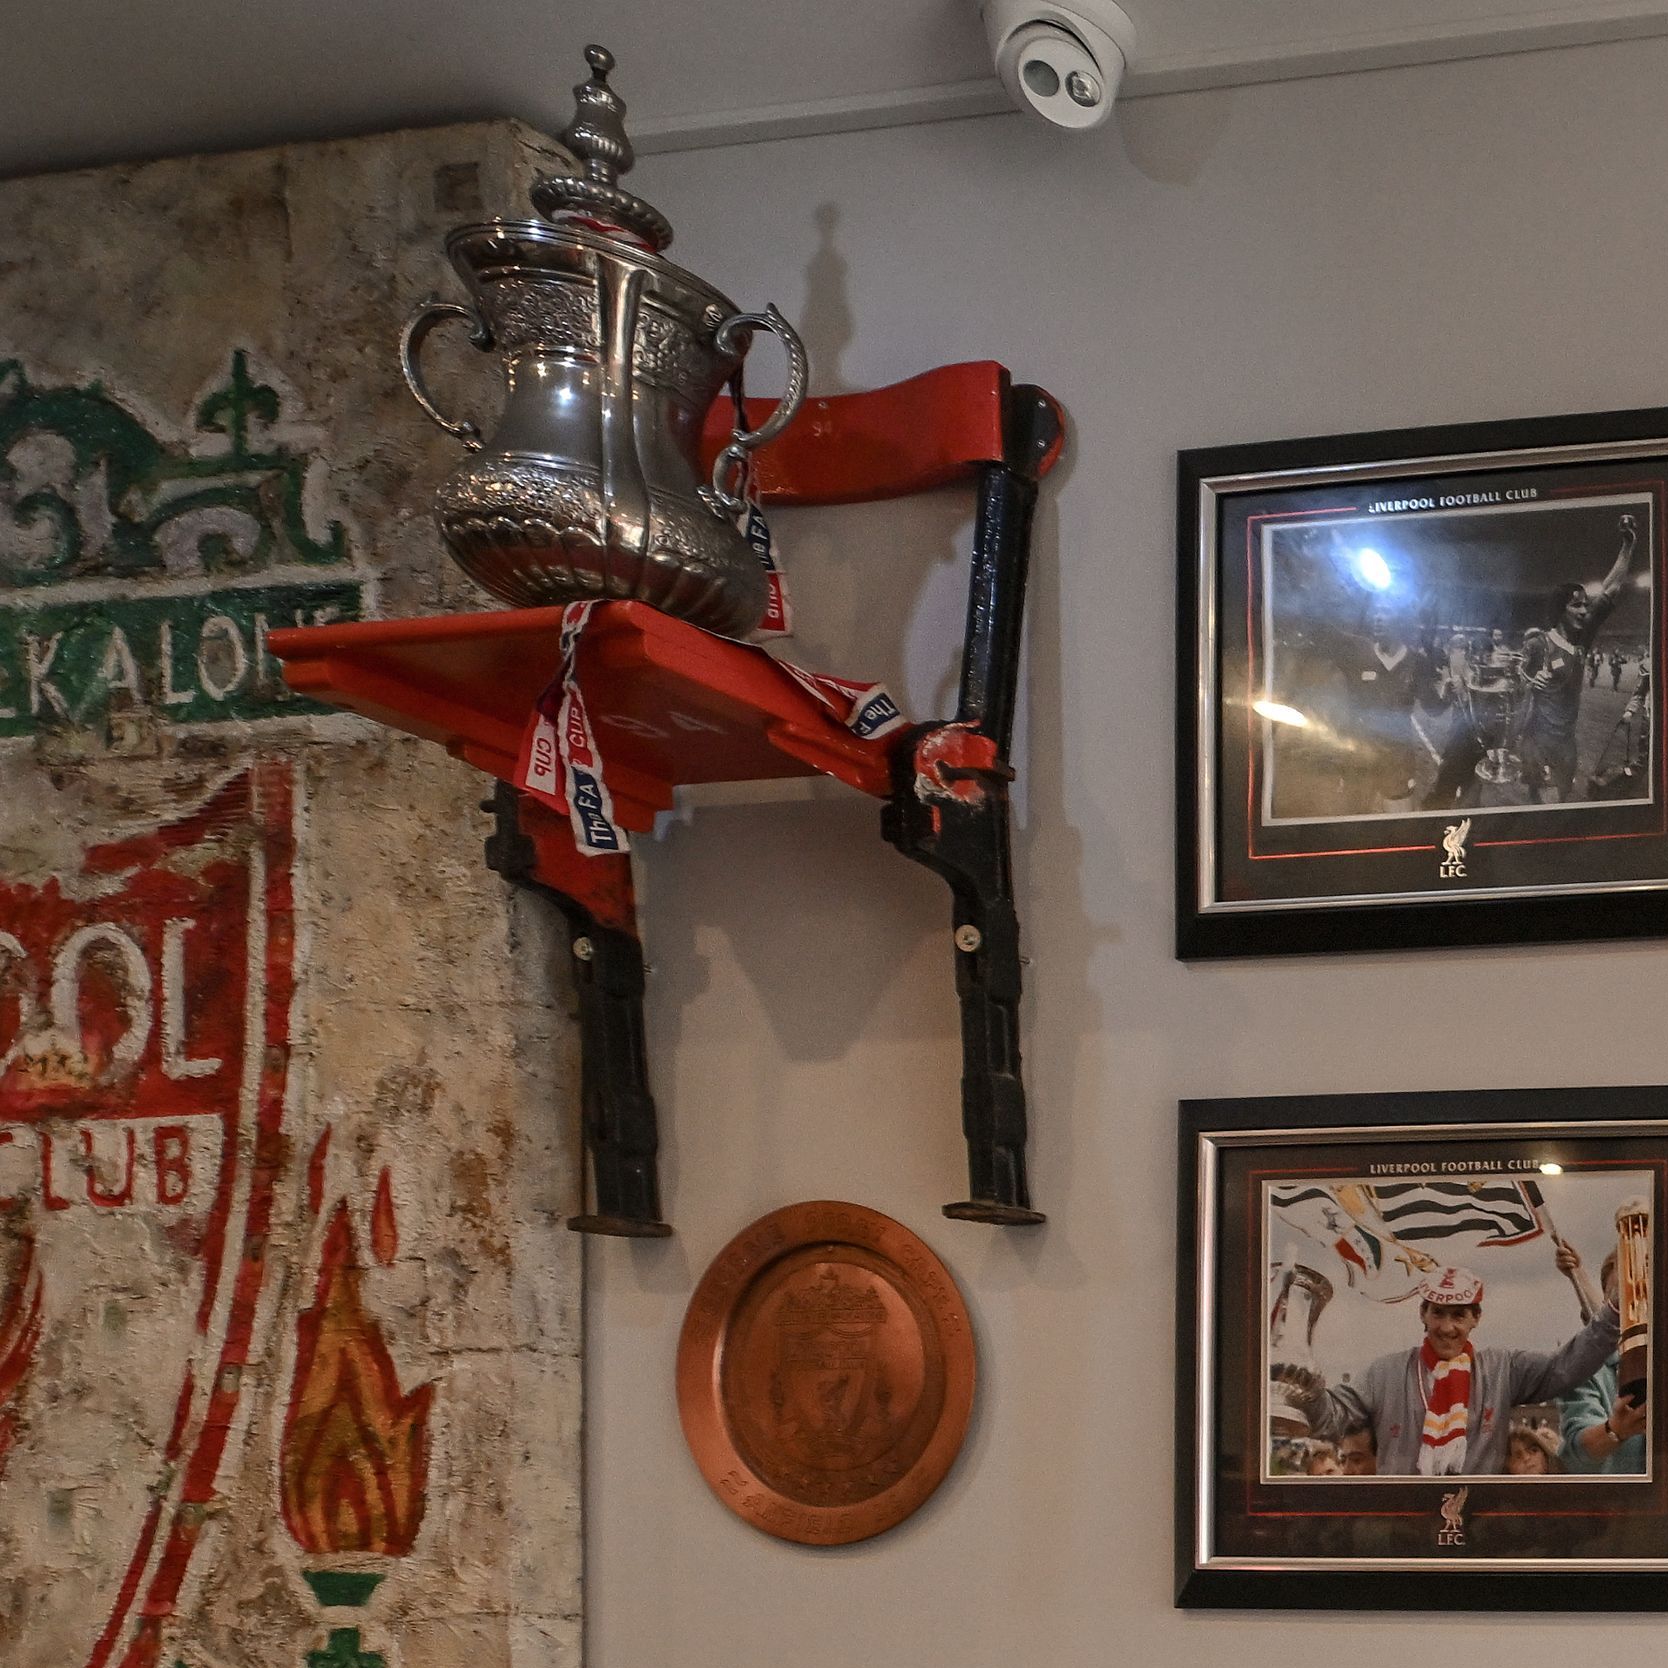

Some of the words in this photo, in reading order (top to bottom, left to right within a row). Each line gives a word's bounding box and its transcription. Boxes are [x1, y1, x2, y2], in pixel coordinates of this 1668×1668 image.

[1368, 496, 1436, 514] LIVERPOOL
[1439, 491, 1502, 508] FOOTBALL
[1505, 487, 1538, 502] CLUB
[567, 706, 586, 748] CUP
[577, 783, 598, 810] FA
[1370, 1161, 1438, 1175] LIVERPOOL
[1440, 1159, 1505, 1172] FOOTBALL
[1508, 1157, 1540, 1170] CLUB
